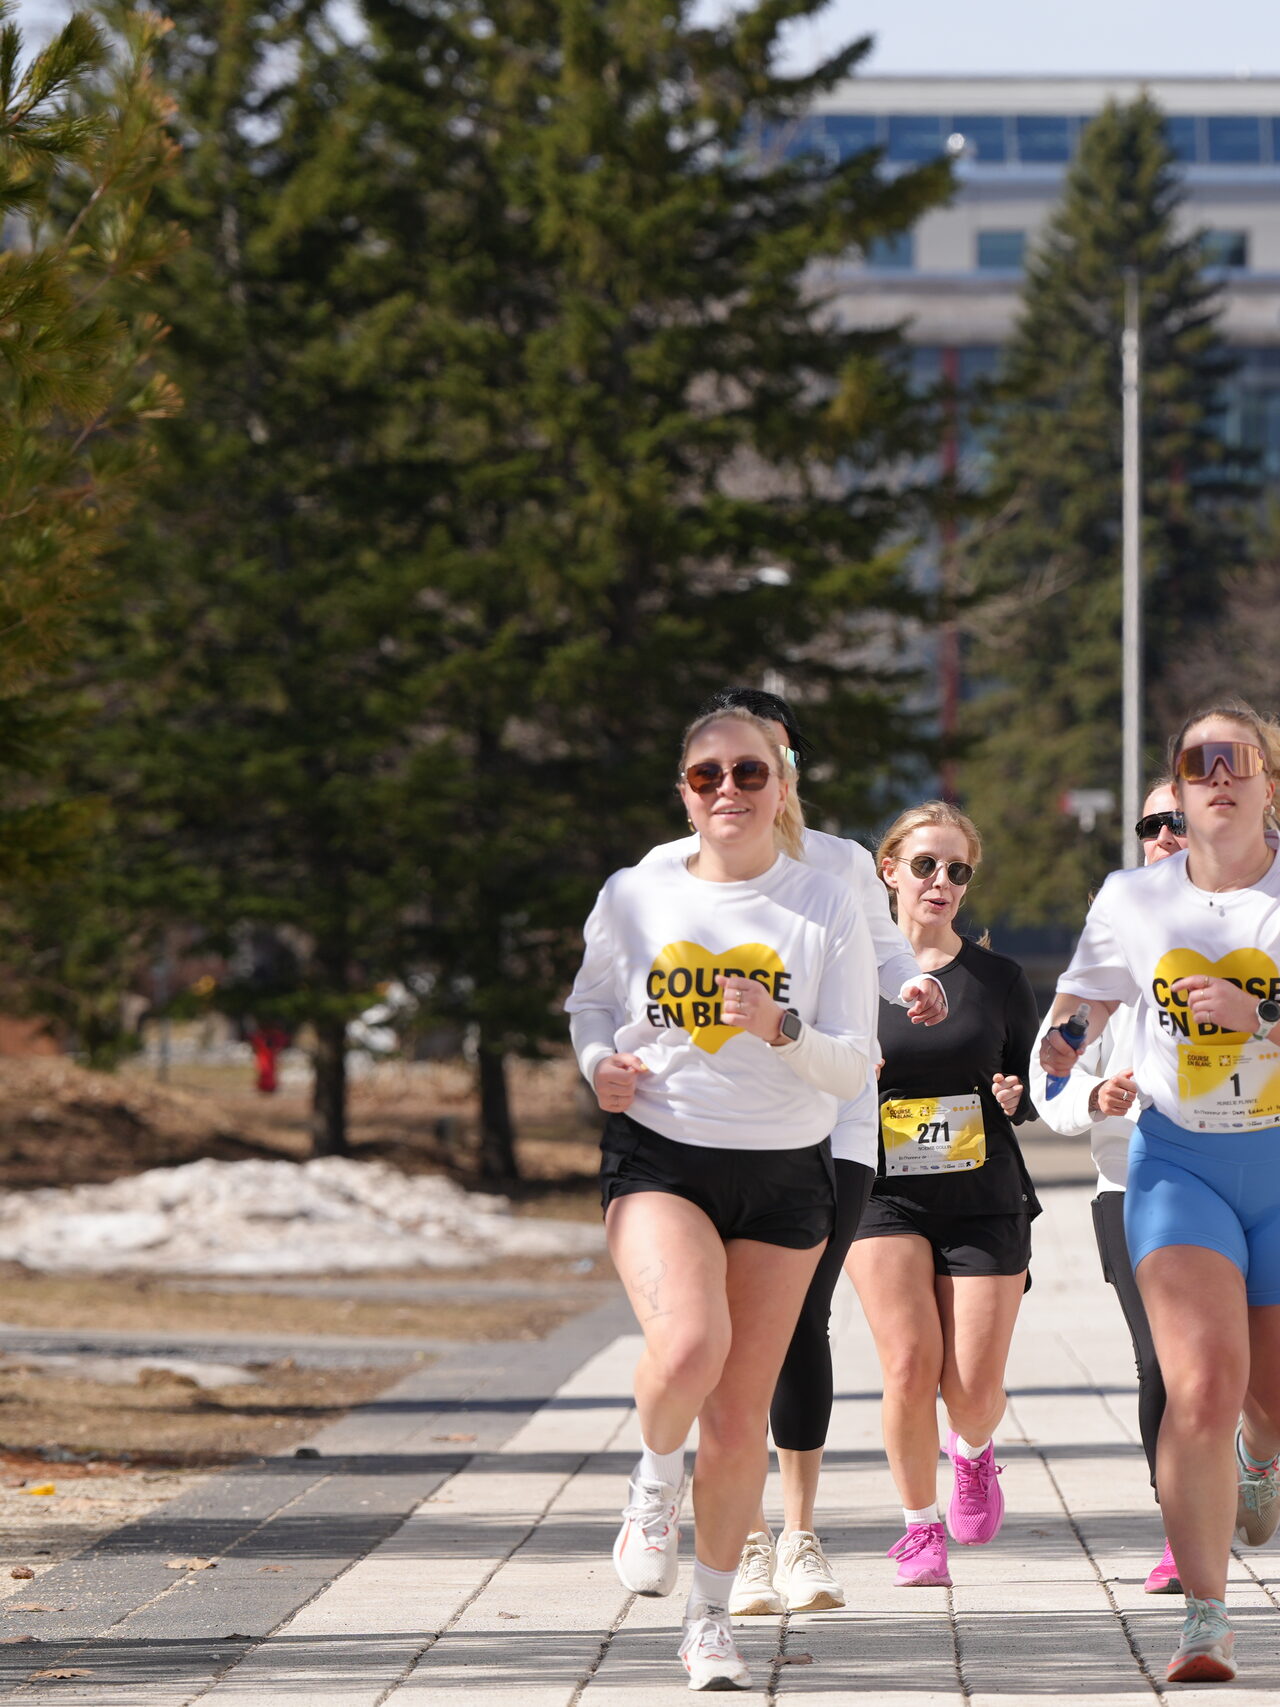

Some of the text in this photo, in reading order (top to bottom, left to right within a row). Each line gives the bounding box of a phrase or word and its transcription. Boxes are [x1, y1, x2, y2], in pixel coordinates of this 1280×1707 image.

[646, 1002, 685, 1028] EN
[1158, 1010, 1190, 1037] EN
[1230, 1073, 1240, 1097] 1
[917, 1121, 950, 1144] 271
